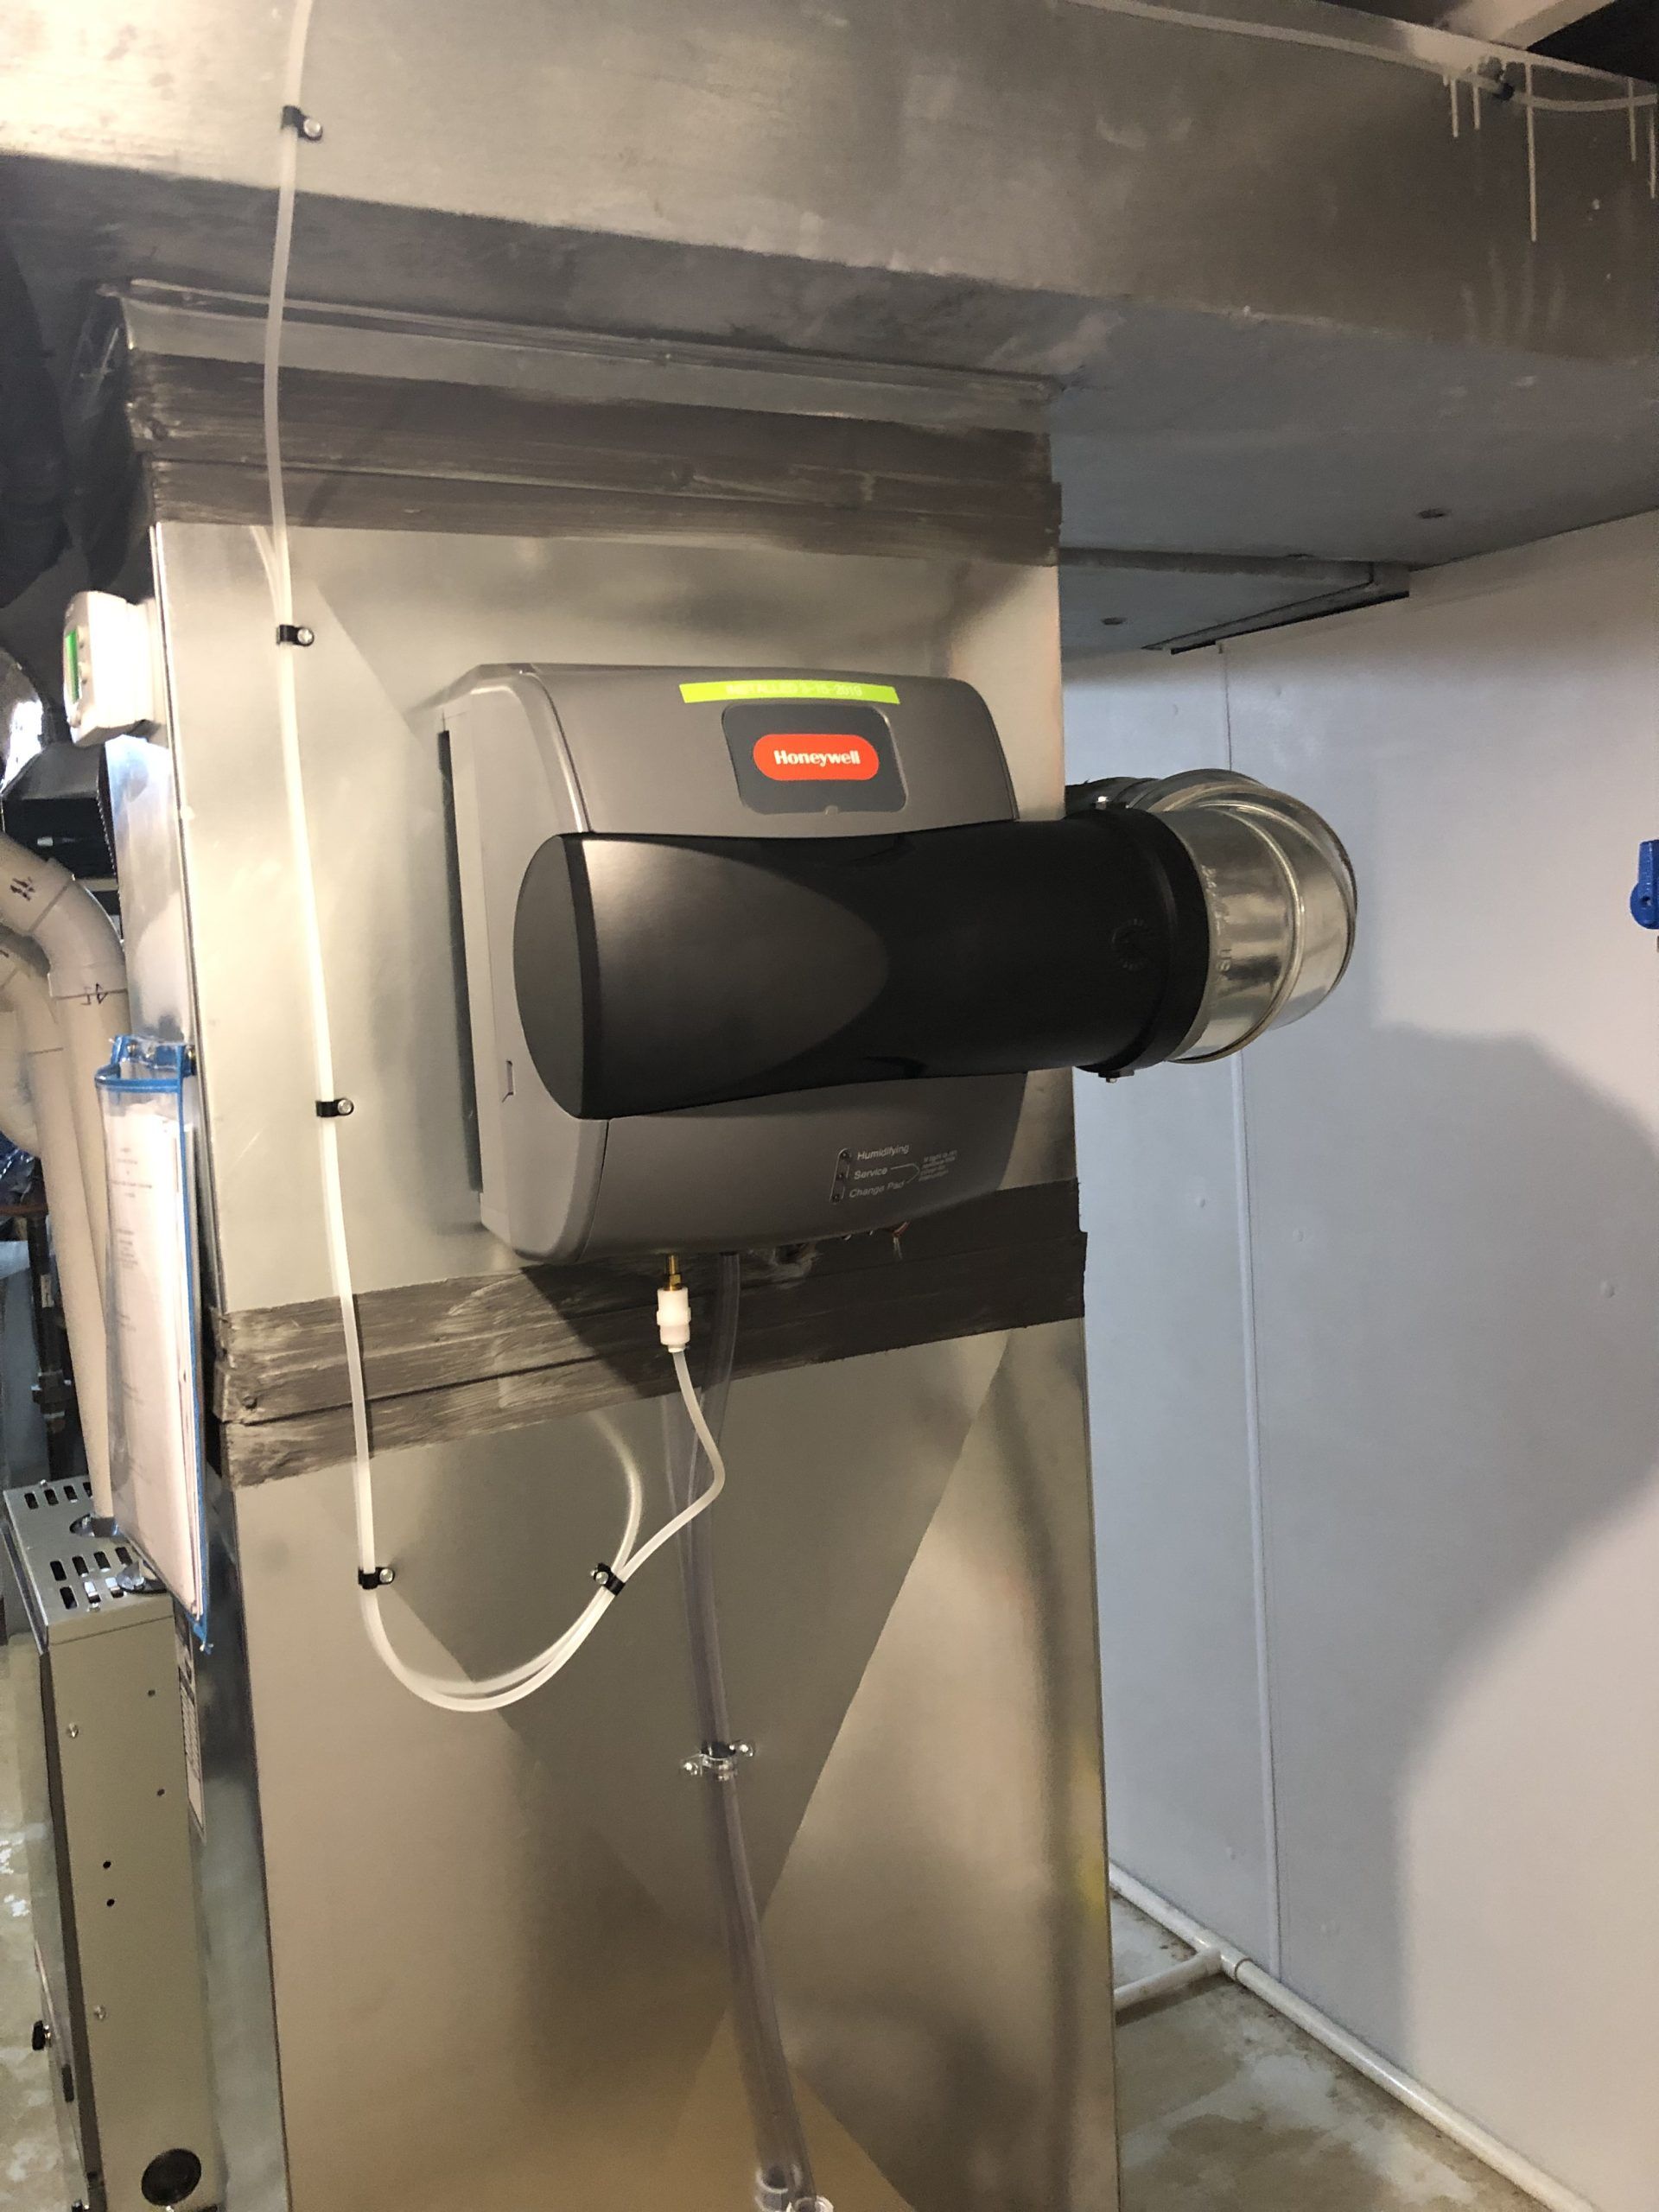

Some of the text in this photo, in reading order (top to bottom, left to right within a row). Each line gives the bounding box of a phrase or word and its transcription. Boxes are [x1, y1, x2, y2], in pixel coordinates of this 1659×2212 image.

[773, 750, 861, 766] Honeywell
[857, 1145, 909, 1160] Humidifying
[854, 1167, 887, 1179] Service
[849, 1180, 905, 1198] Change Pad
